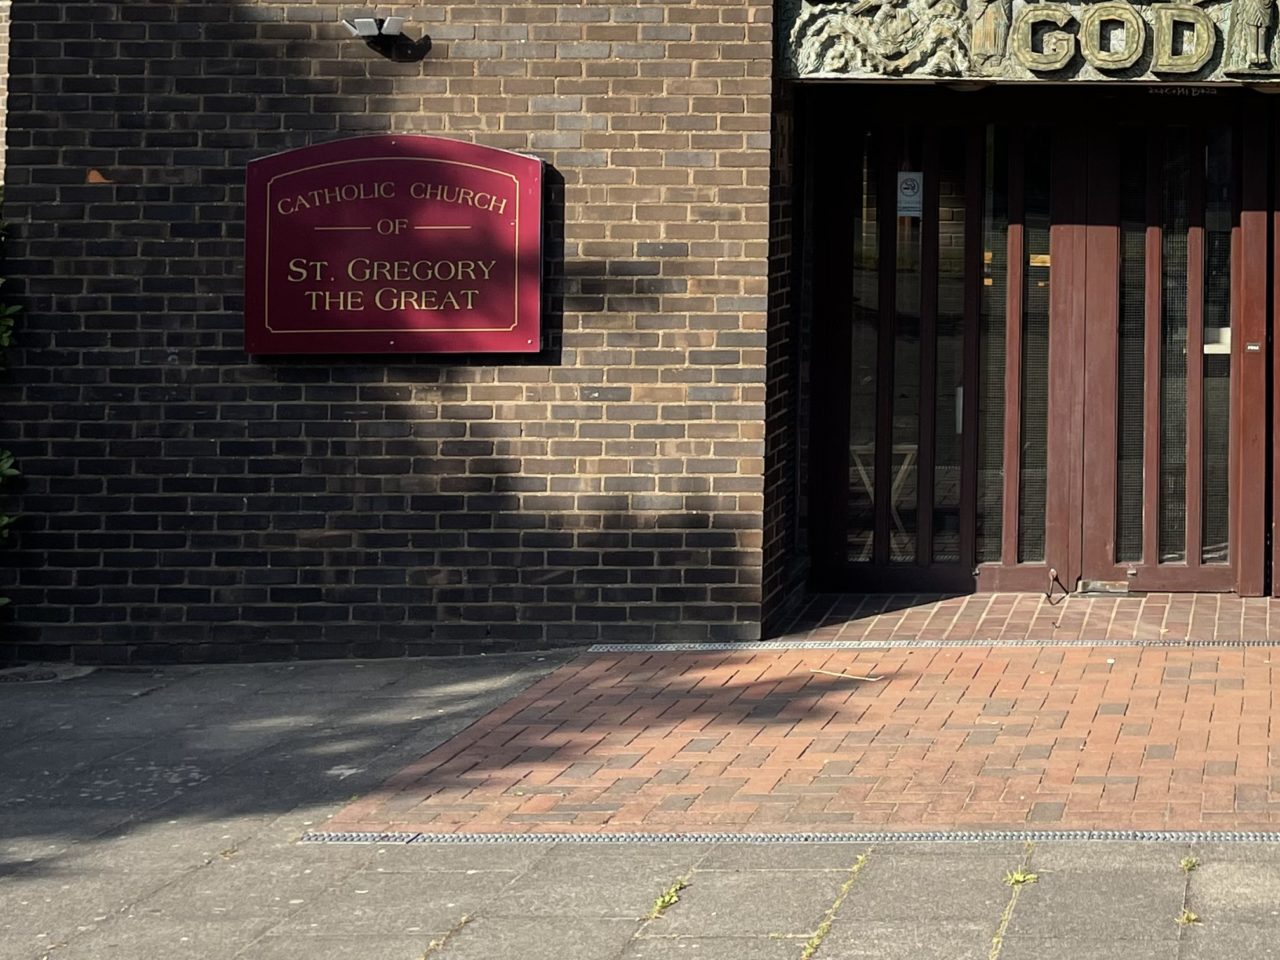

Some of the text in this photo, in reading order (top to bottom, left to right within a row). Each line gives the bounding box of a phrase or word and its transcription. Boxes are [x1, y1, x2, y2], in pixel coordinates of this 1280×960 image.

[1011, 1, 1215, 74] GOD
[277, 181, 508, 215] CATHOLIC CHURCH
[376, 218, 409, 235] OF
[347, 257, 497, 282] GREGORY
[304, 287, 480, 311] THE GREAT
